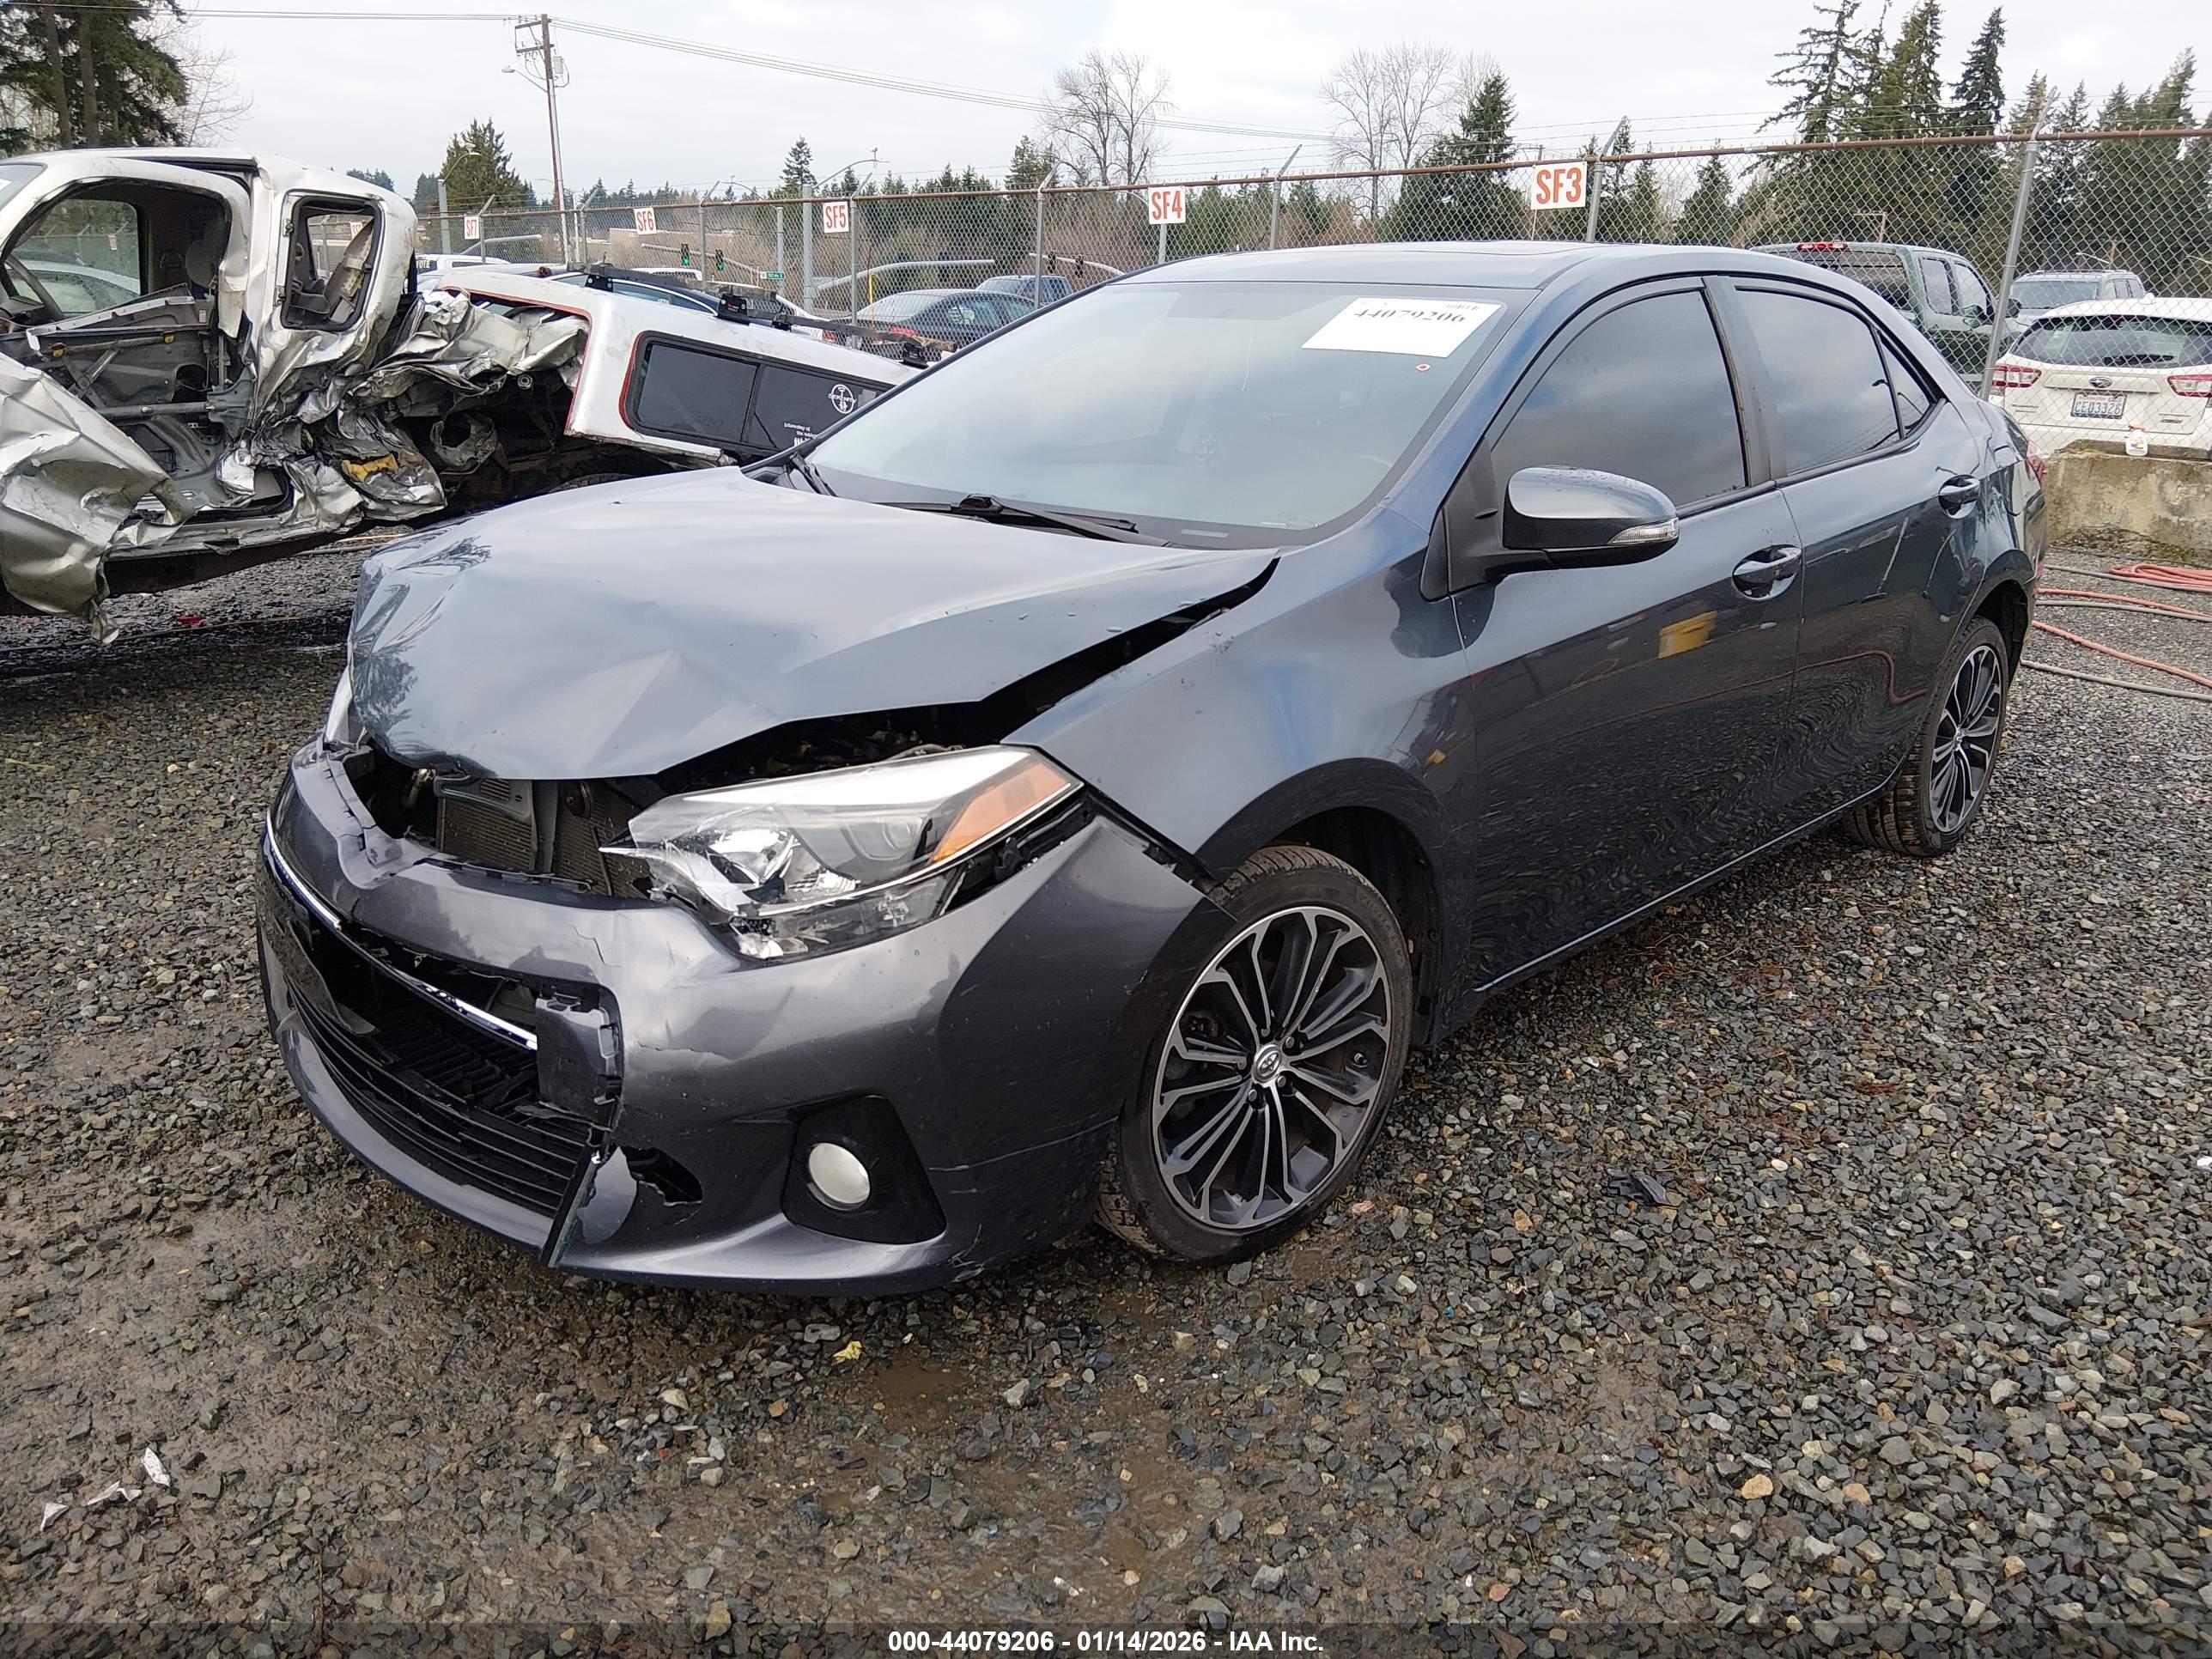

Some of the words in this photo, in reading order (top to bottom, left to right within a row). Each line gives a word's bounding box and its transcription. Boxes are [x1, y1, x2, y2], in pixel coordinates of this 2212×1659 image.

[1536, 167, 1582, 204] SF3
[825, 204, 846, 228] SF5
[1152, 190, 1182, 220] SF4
[466, 219, 477, 237] SF7
[636, 210, 654, 232] SF6
[1353, 308, 1465, 322] 44079206
